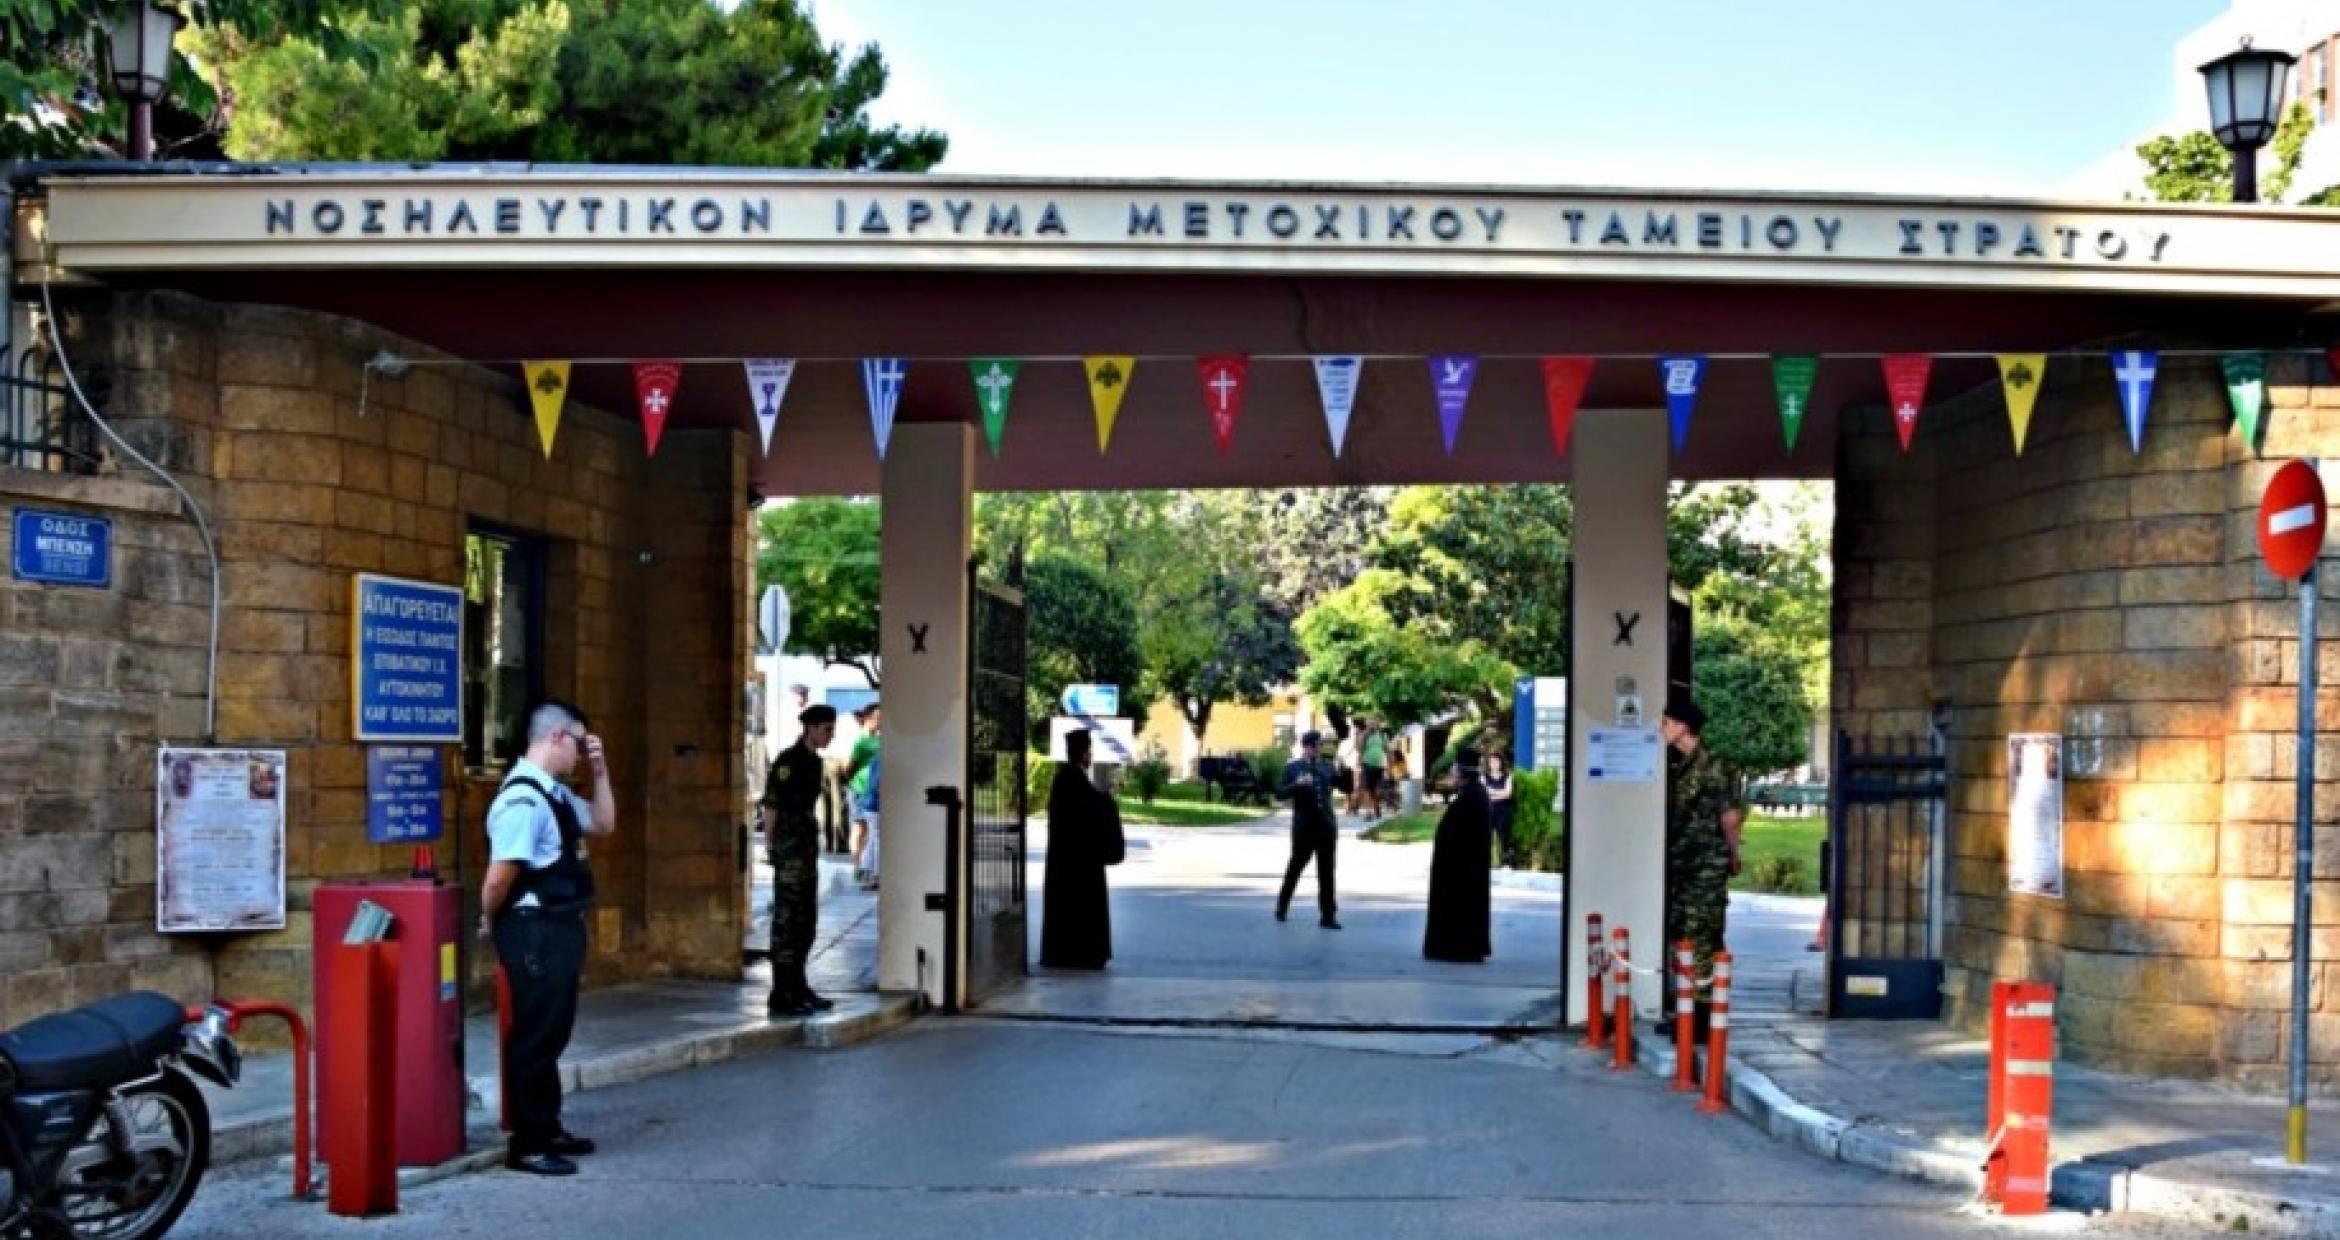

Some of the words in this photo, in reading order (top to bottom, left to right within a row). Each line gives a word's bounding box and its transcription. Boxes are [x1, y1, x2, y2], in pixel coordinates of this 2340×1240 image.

[264, 197, 774, 237] ΝΟΣΗΛΕΥΤΙΚΟΝ
[834, 199, 1070, 238] ΙΔΡΥΜΑ
[1126, 199, 1508, 244] ΜΕΤΟΧΙΚΟΥ
[1560, 207, 1844, 252] ΤΑΜΕΙΟΥ
[1897, 217, 2174, 264] ΣΤΡΑΤΟΥ
[41, 518, 88, 537] ΟΔΟΣ
[364, 593, 459, 624] ΑΠΑΓΟΡΕΥΕΤΑΙ
